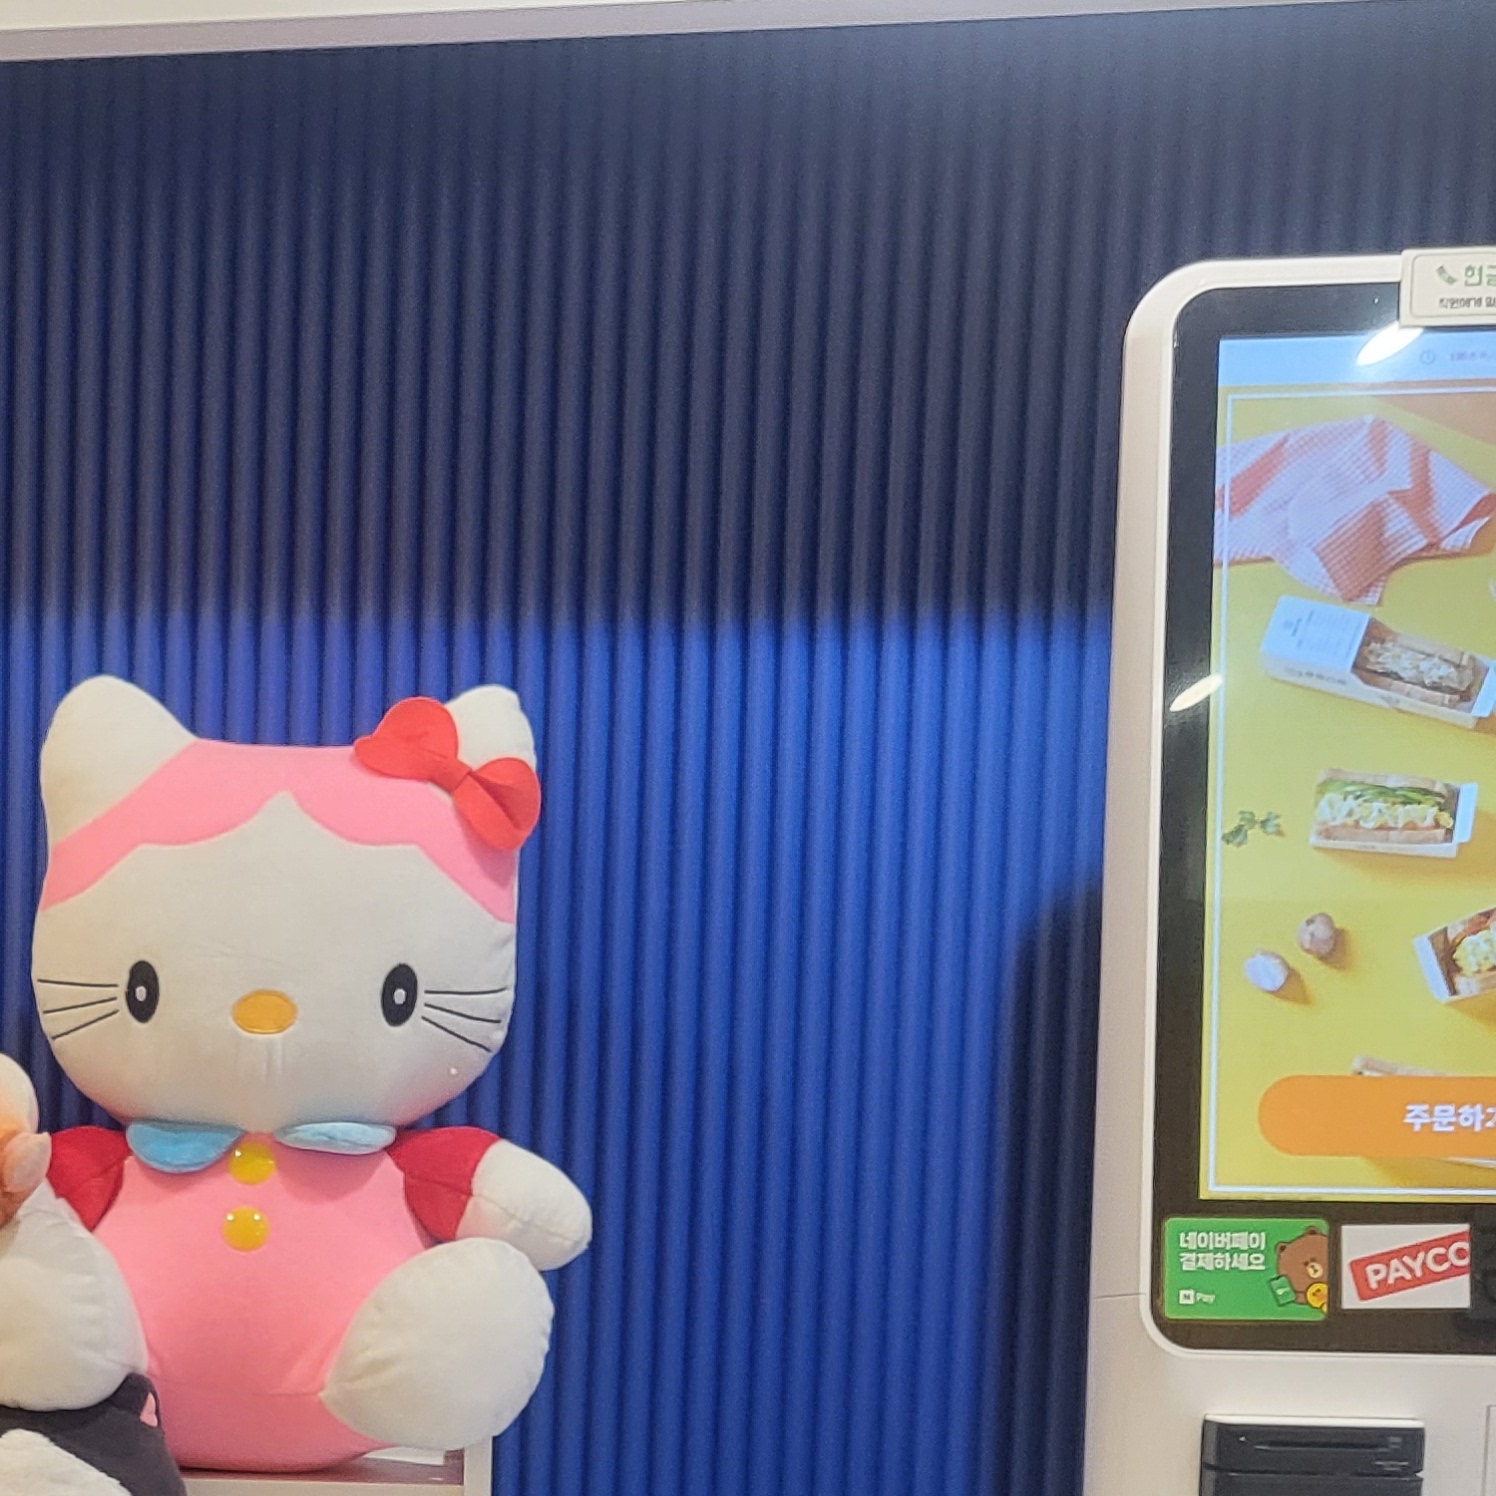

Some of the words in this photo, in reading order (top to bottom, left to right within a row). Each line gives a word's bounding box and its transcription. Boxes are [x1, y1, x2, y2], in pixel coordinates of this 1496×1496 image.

[1179, 1231, 1266, 1250] 네이버페이
[1179, 1252, 1266, 1271] 결제하세요
[1364, 1241, 1470, 1290] PAYCO
